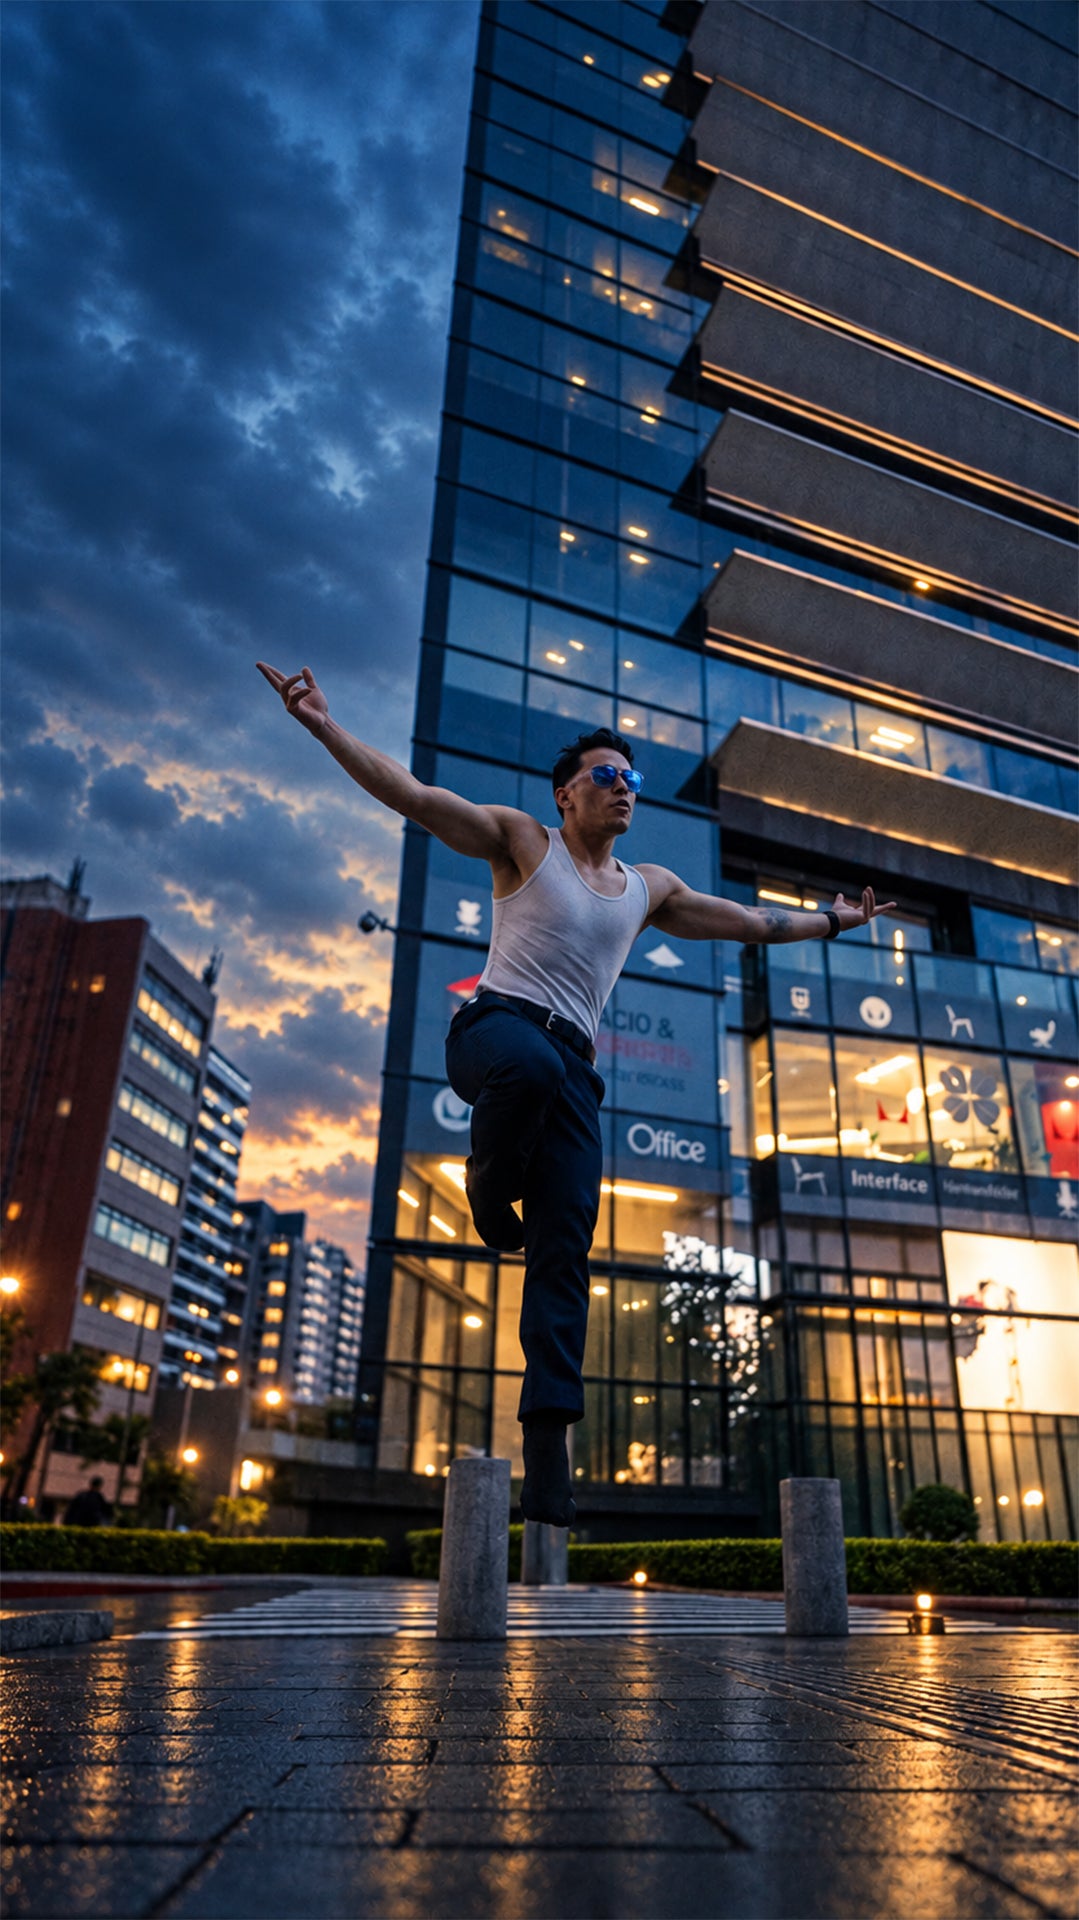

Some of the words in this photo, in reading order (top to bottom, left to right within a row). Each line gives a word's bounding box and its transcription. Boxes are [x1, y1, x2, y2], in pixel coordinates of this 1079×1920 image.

[657, 1017, 675, 1041] &
[627, 1122, 706, 1163] Office
[851, 1169, 929, 1194] Interface
